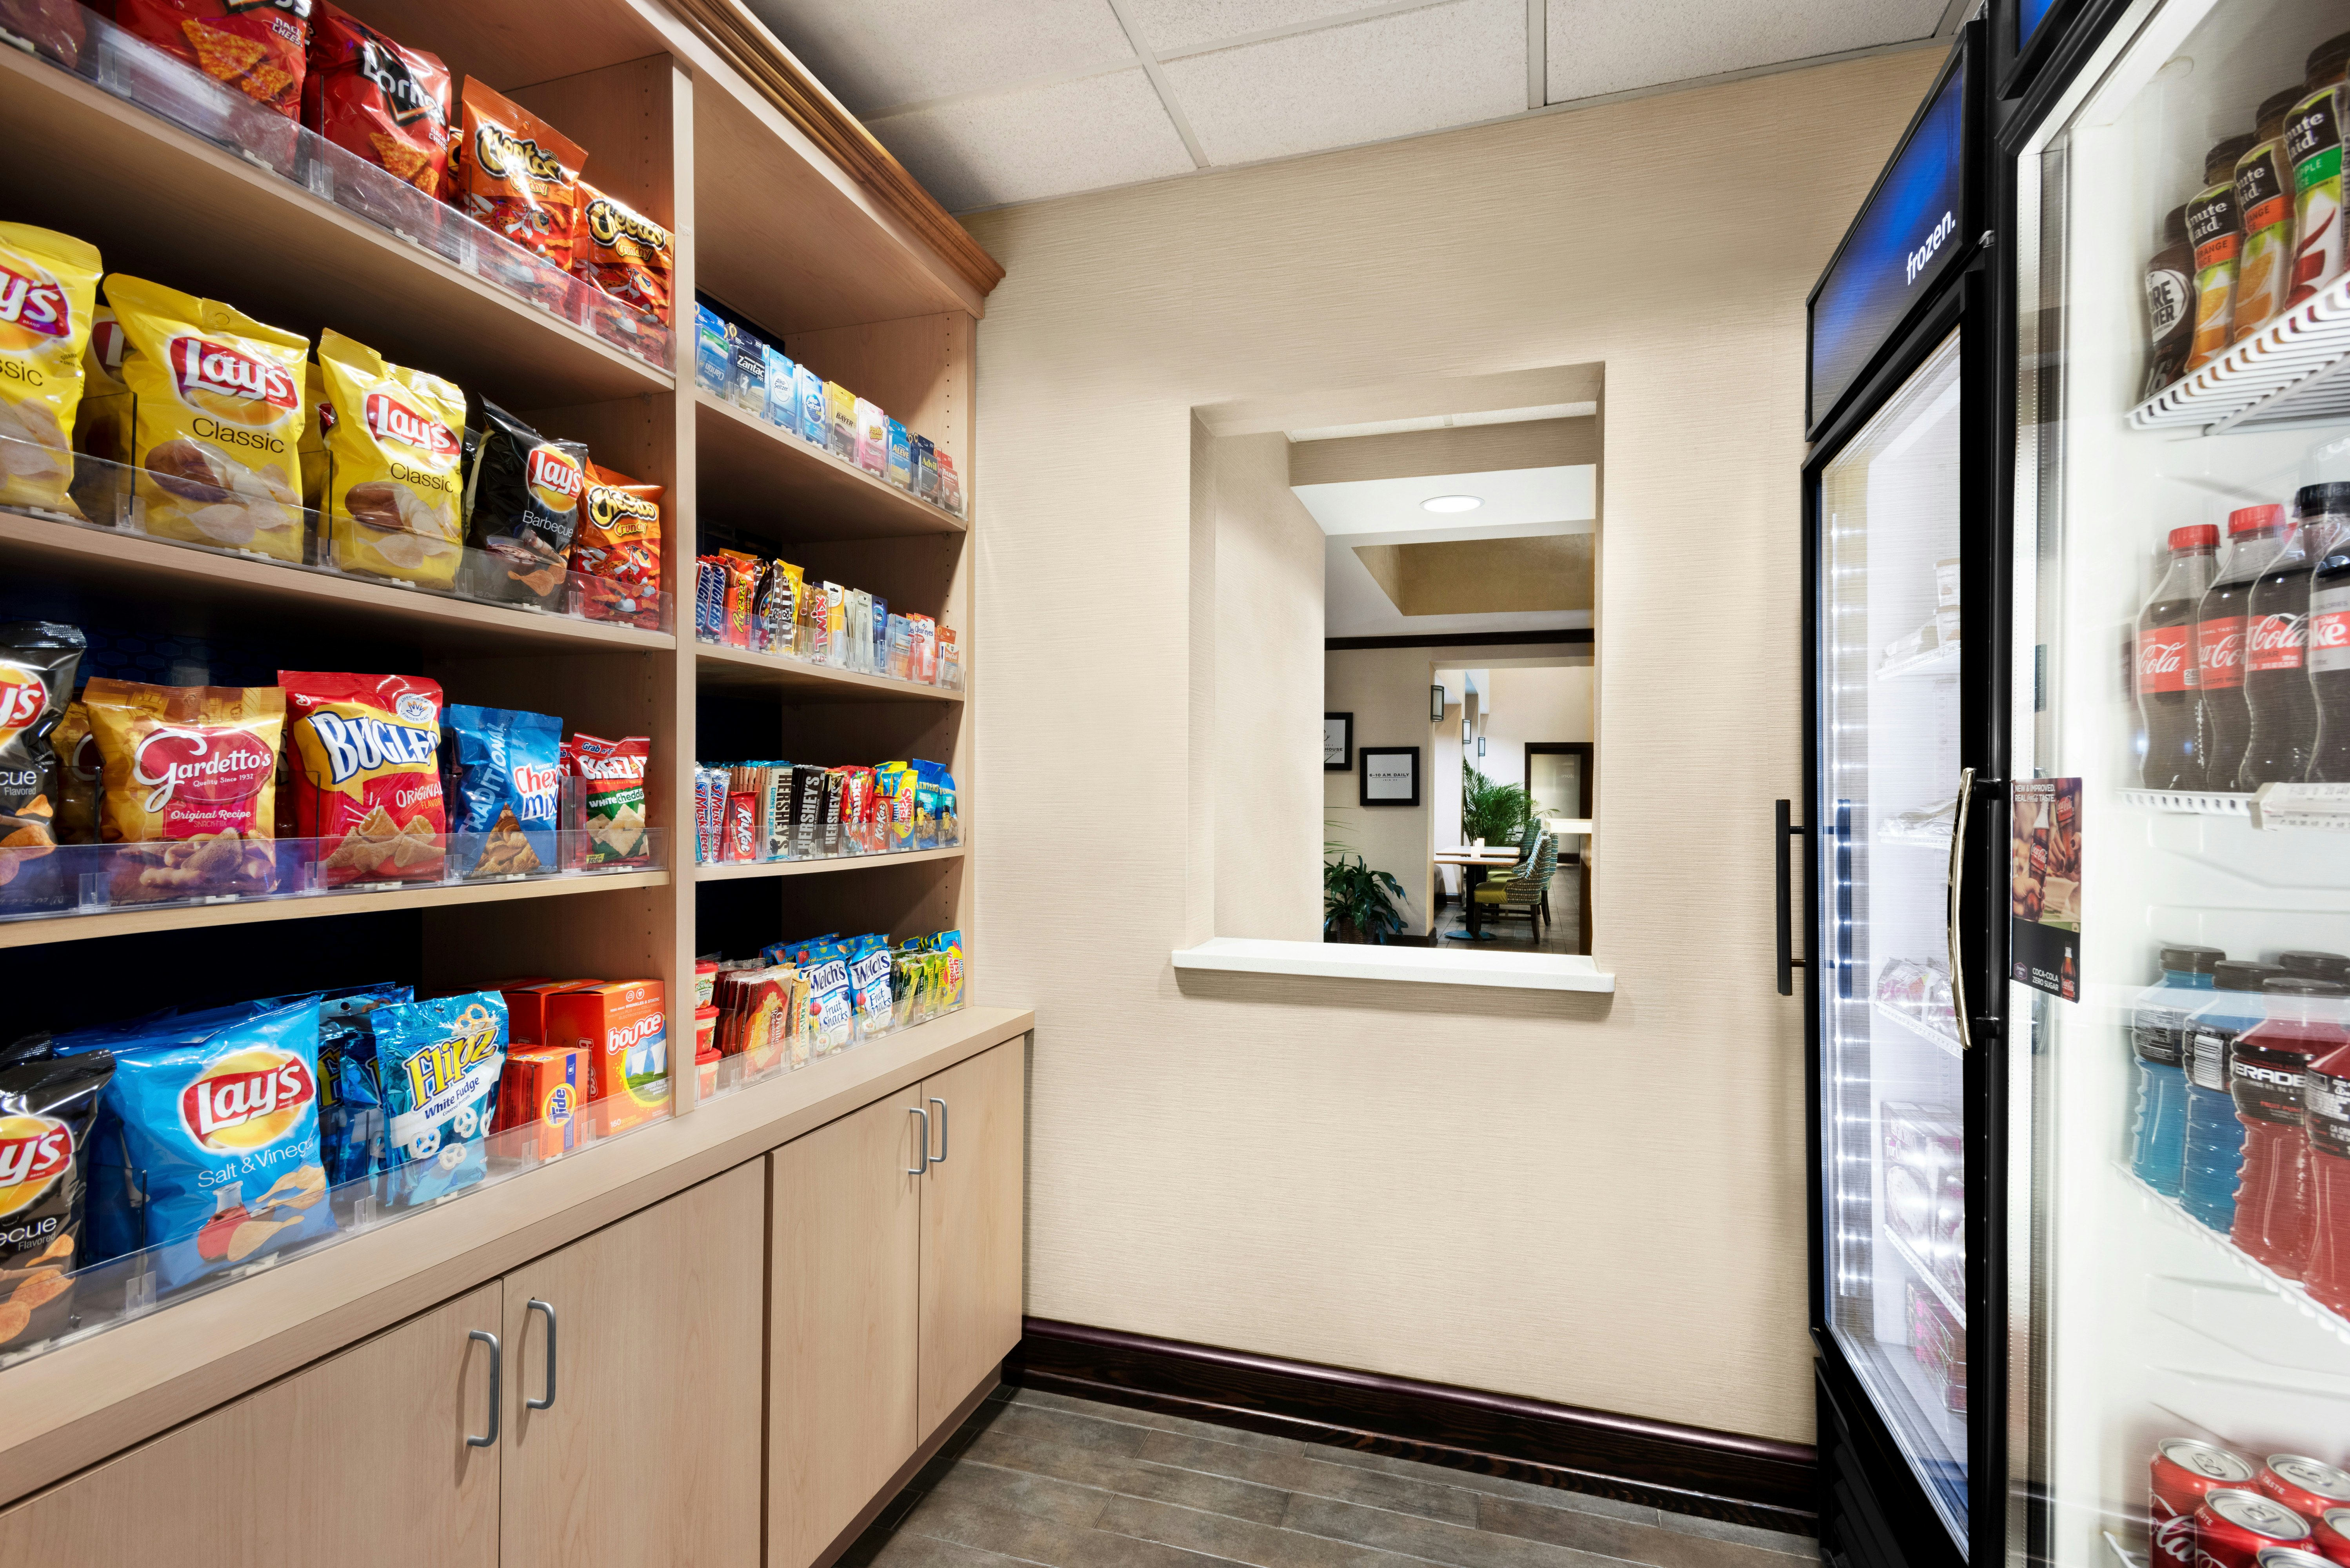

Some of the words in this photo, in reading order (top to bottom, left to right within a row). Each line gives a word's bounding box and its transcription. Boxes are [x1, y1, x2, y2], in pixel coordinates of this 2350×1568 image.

[616, 241, 652, 260] Crunchy
[1906, 211, 1956, 285] frozen.
[23, 319, 40, 328] BRAND
[184, 339, 290, 400] Lay's
[737, 355, 765, 377] Zantac
[774, 383, 789, 391] Seltzer
[806, 401, 821, 411] Seltzer
[807, 396, 819, 405] Alka-
[377, 395, 451, 450] Lay's
[836, 412, 853, 427] BAYER
[869, 425, 883, 434] Pepto-
[192, 417, 285, 454] Classic
[892, 444, 909, 459] ALEVE
[922, 456, 938, 471] Advil
[390, 462, 454, 494] Classic
[532, 451, 582, 496] Lay's
[942, 467, 958, 481] TYLENOL
[591, 488, 656, 526] Cheetos
[522, 510, 574, 536] Barbecue
[614, 521, 647, 536] Crunchy
[708, 566, 725, 630] SNICKERS
[732, 577, 747, 633] Reese's
[814, 595, 827, 652] TWIX
[945, 651, 958, 660] DayQuil
[402, 713, 419, 722] FINGER
[582, 742, 601, 753] Grab
[134, 728, 271, 813] Gardetto's
[535, 762, 554, 771] SAVORY
[4, 786, 36, 795] Flavored
[193, 779, 218, 788] Quality
[458, 723, 505, 839] TRADITIONAL
[514, 764, 559, 794] Chex
[711, 783, 723, 797] 3
[421, 798, 442, 810] FLAVOR
[524, 789, 557, 819] mix
[589, 796, 617, 808] WHITE
[775, 774, 792, 850] HERSHEY'S
[798, 776, 820, 850] HERSHEY'S
[850, 778, 862, 833] Skittles
[901, 787, 912, 833] Swedish
[170, 809, 216, 821] Original
[218, 809, 251, 821] Recipe
[825, 786, 840, 845] HERSHEY'S
[696, 797, 709, 861] Musketeers
[711, 796, 723, 860] Musketeers
[2030, 843, 2048, 864] Coca-Cola
[811, 964, 846, 992] Welch's
[852, 954, 890, 984] Welch's
[947, 951, 956, 993] Swedish
[2032, 967, 2059, 982] COCA-COLA
[2032, 976, 2044, 986] ZERO
[2044, 980, 2059, 991] SUGAR
[625, 1000, 644, 1009] WRINKLES
[825, 1000, 842, 1017] Fruit
[869, 988, 885, 1007] Fruit
[609, 1014, 662, 1053] bounce
[770, 1007, 779, 1052] Redenbacher's
[775, 1010, 783, 1044] Orville
[405, 1029, 496, 1111] Flipz
[197, 1064, 302, 1135] Lay's
[425, 1096, 455, 1120] White
[456, 1076, 480, 1100] Fudge
[442, 1103, 459, 1116] Covered
[458, 1094, 471, 1108] Pretzels
[551, 1088, 571, 1125] Tide
[610, 1118, 621, 1128] 160
[298, 1150, 318, 1165] Flavored
[197, 1167, 238, 1189] Salt
[240, 1159, 257, 1175] &
[18, 1231, 56, 1251] Flavored
[2263, 1474, 2285, 1495] TASTE
